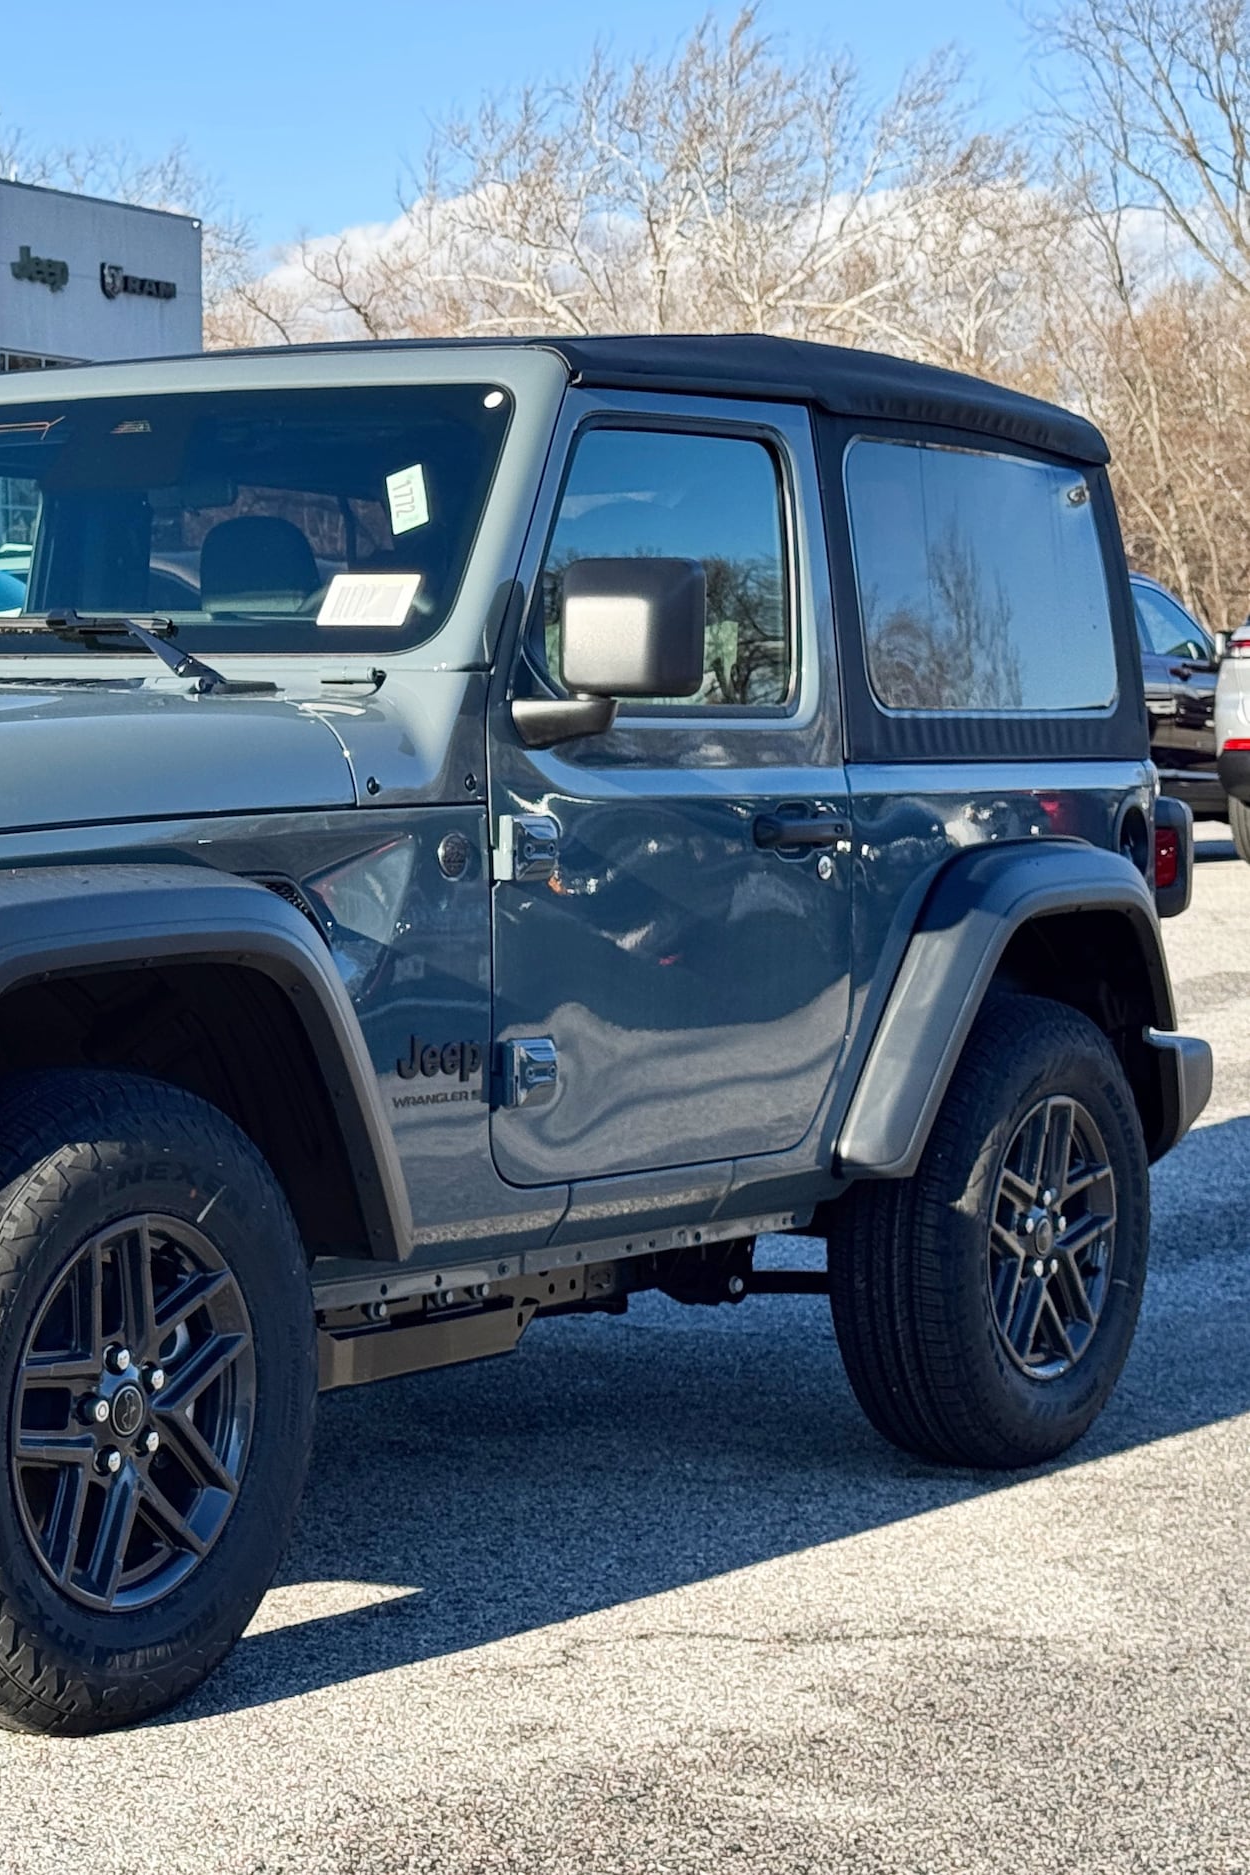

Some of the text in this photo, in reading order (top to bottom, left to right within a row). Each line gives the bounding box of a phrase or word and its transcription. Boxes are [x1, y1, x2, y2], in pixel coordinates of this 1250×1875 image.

[10, 245, 69, 294] Jeep
[122, 275, 177, 300] RAM
[392, 479, 416, 519] 1772
[397, 1034, 483, 1082] Jeep
[391, 1090, 470, 1110] WRANGLER
